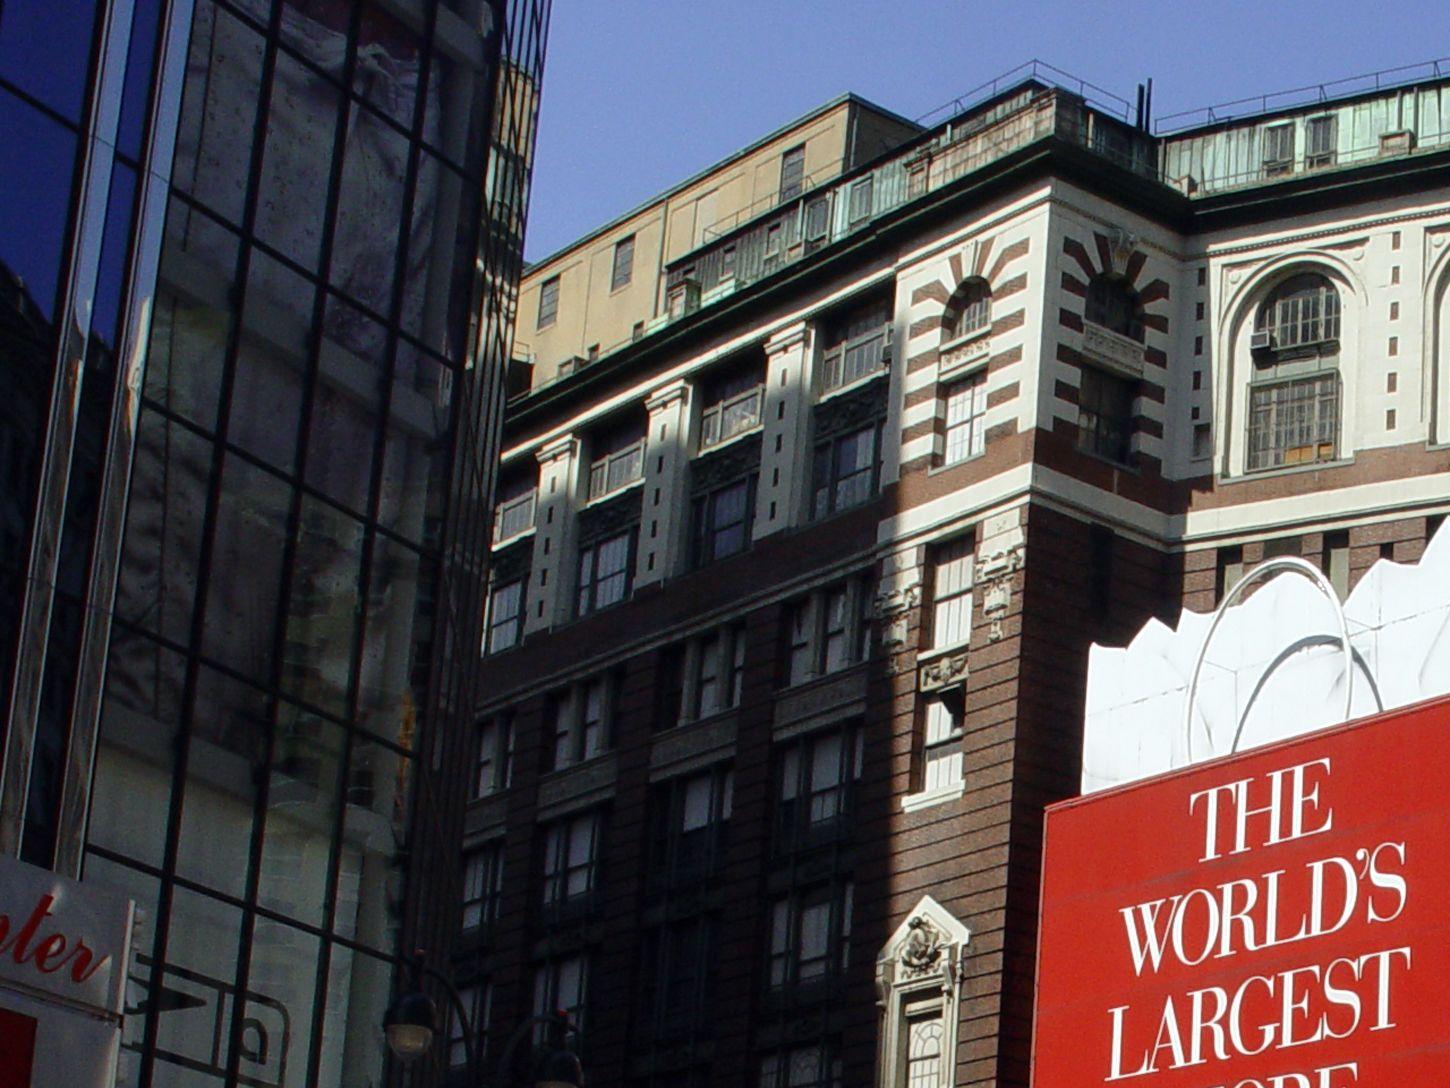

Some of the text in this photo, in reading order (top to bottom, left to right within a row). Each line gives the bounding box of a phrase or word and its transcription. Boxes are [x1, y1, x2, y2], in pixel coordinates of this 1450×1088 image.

[1188, 757, 1332, 863] THE
[1118, 842, 1406, 978] WORLD'S
[1104, 947, 1411, 1082] LARGEST
